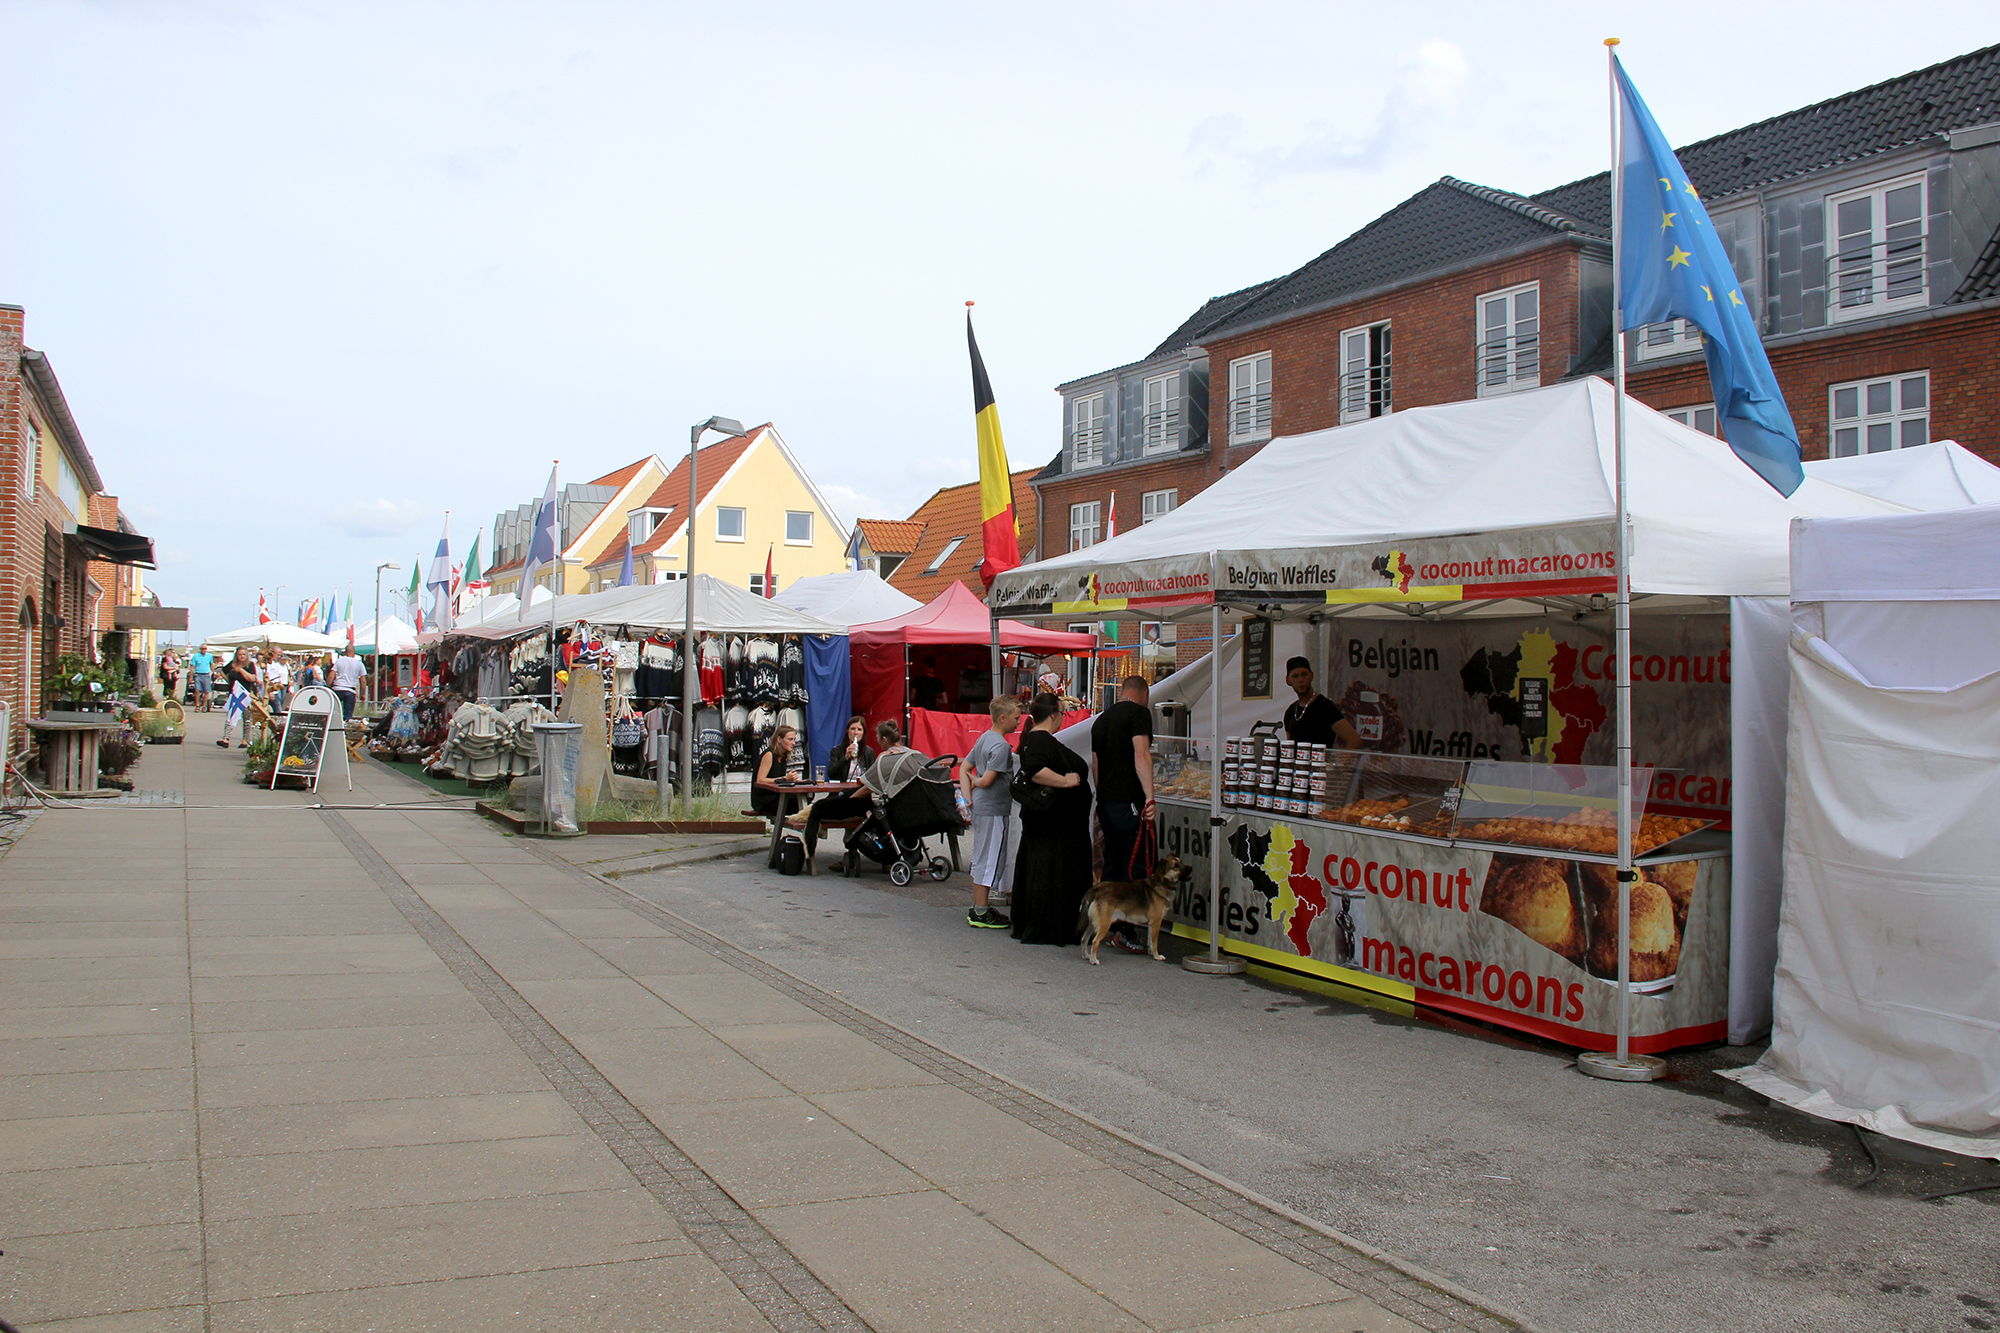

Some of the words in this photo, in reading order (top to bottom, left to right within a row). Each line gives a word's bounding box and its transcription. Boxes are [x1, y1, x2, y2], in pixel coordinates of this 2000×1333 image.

[1228, 566, 1278, 589] Belgian
[1281, 565, 1336, 585] Waffles
[1420, 556, 1494, 580] coconut
[1497, 550, 1615, 575] macaroons
[1027, 583, 1058, 599] Waffles
[1104, 578, 1144, 595] coconut
[1146, 573, 1209, 592] macaroons
[1348, 638, 1439, 678] Belgian
[1581, 644, 1731, 684] Coconut
[1360, 716, 1380, 726] nutella
[1408, 729, 1500, 761] Waffles
[1323, 852, 1472, 912] coconut
[1362, 936, 1584, 1022] macaroons
